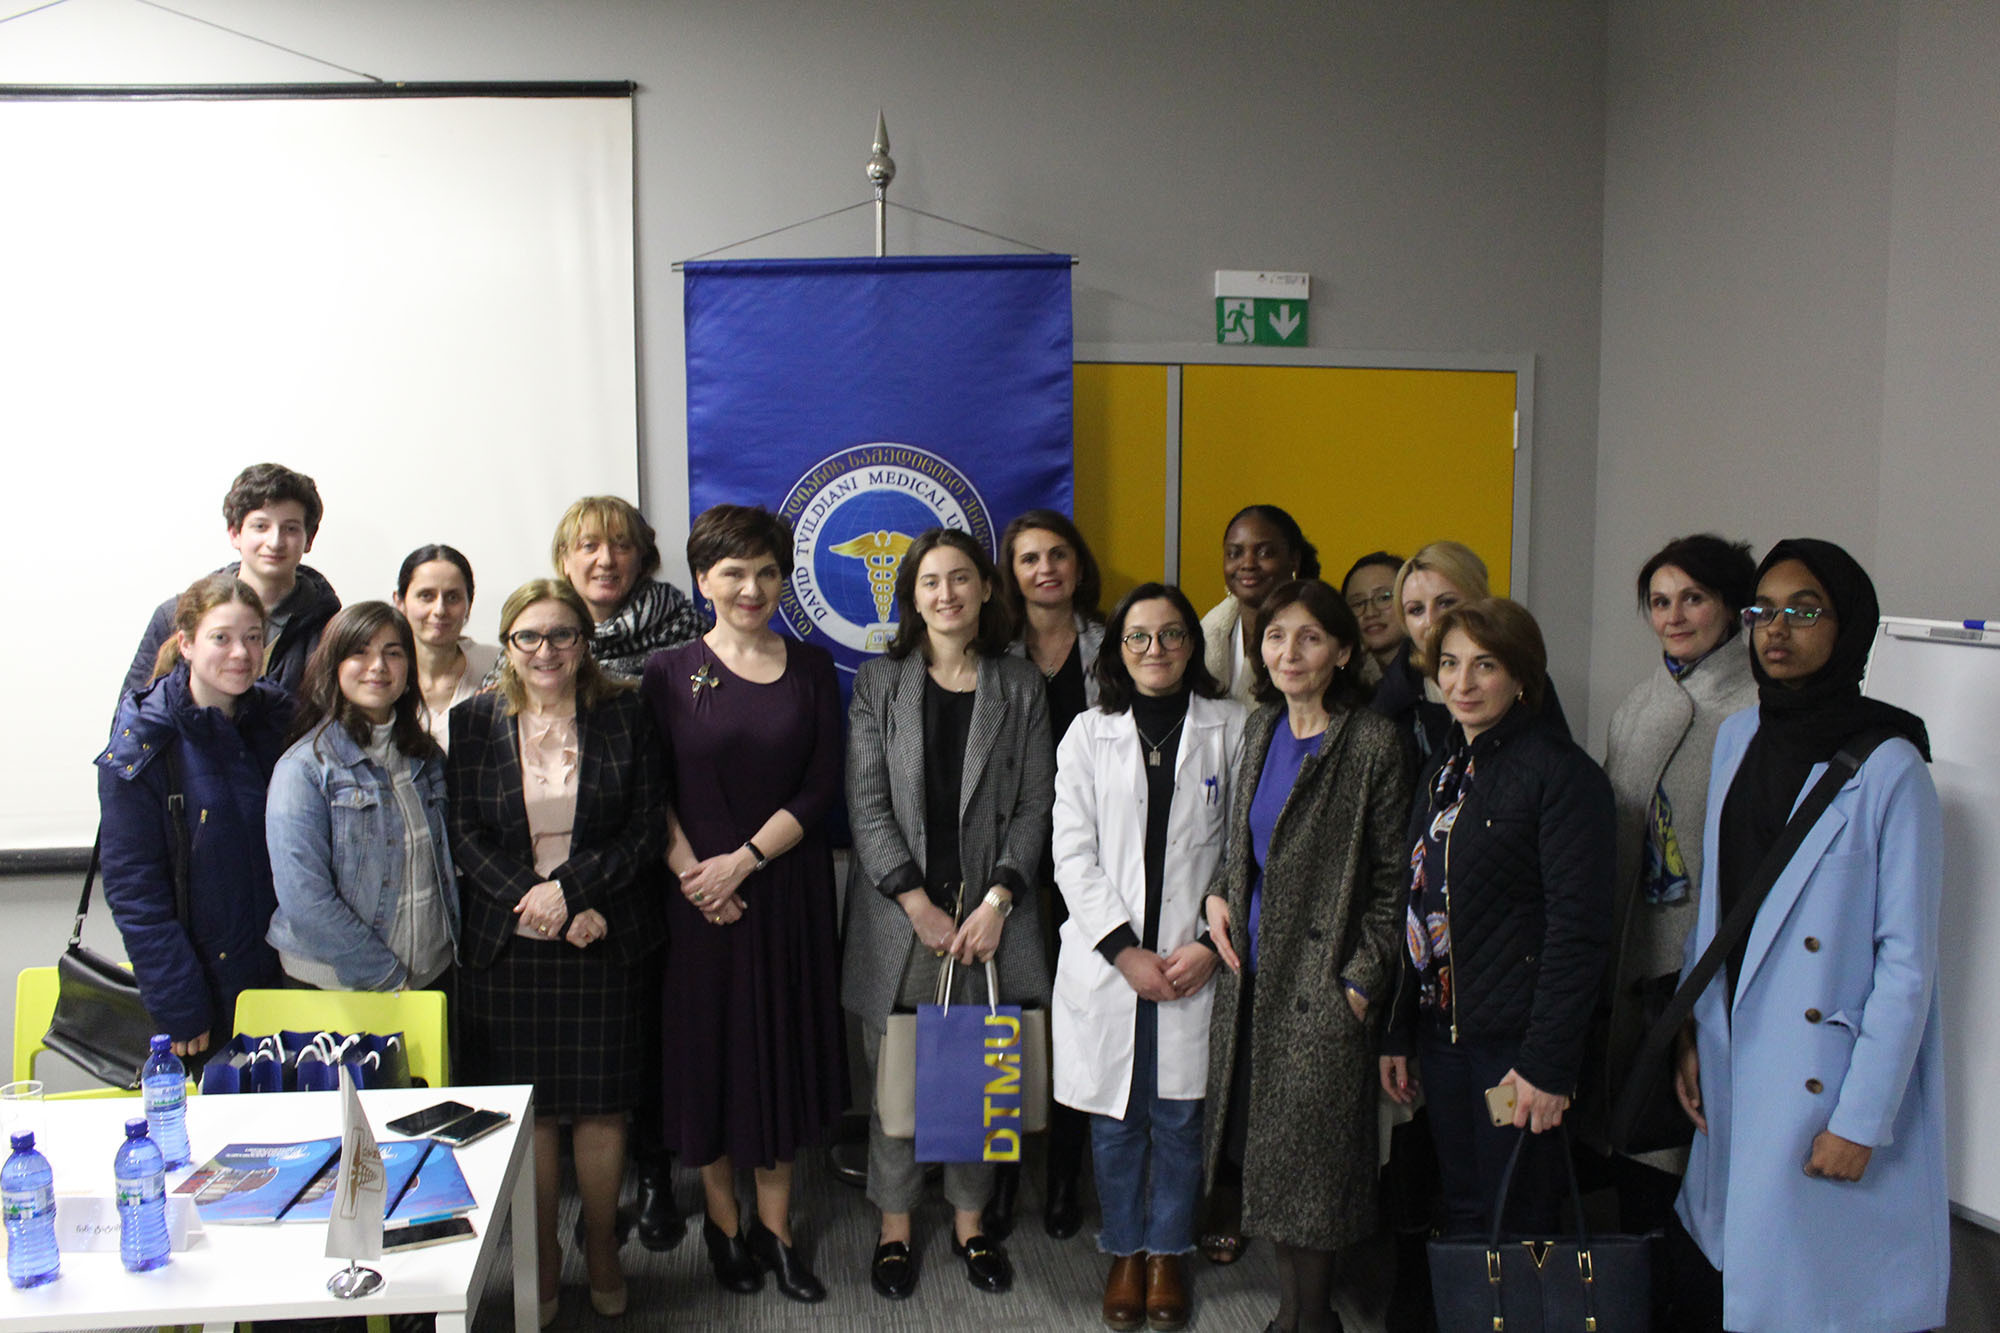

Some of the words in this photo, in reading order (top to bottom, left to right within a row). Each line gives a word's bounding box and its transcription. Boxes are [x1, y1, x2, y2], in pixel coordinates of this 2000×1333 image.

[848, 447, 967, 496] სამედიცინო
[869, 469, 947, 511] MEDICAL
[796, 476, 859, 556] TVILDIANI
[796, 566, 828, 621] DAVID
[983, 1015, 1021, 1162] DTMU
